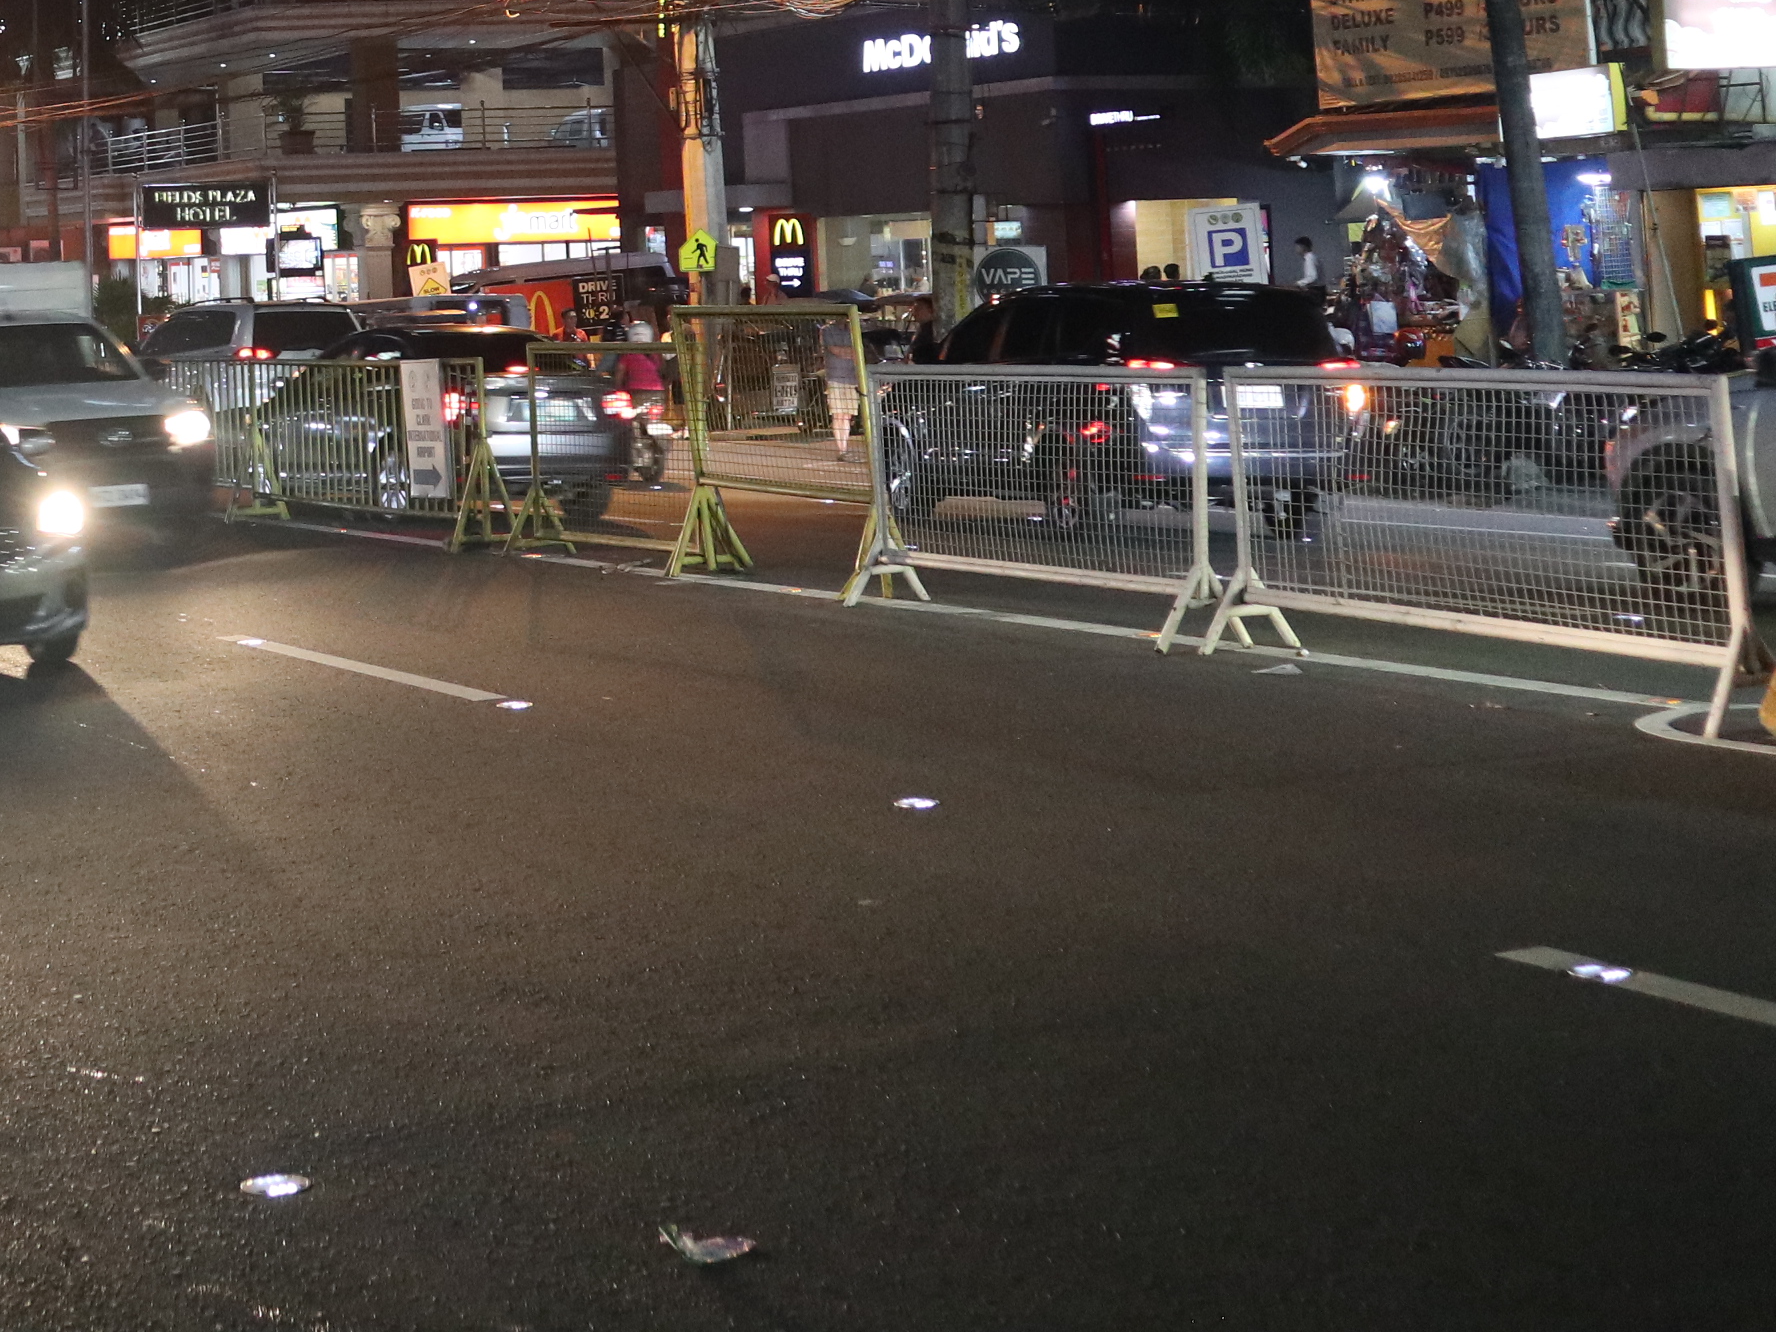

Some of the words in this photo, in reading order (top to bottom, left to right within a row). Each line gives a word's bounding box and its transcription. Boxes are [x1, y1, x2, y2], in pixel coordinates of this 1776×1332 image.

[1331, 7, 1395, 31] DELUXE
[1332, 34, 1390, 56] FAMILY
[1425, 26, 1466, 47] P599
[1523, 15, 1561, 36] URS
[154, 189, 205, 204] FIELDS
[208, 188, 257, 203] PLAZA
[176, 205, 237, 221] HOTEL
[1212, 231, 1244, 266] P
[775, 256, 806, 268] DRIVE
[777, 267, 804, 278] THRU
[980, 267, 1036, 285] VAPE
[423, 286, 441, 294] SLOW
[411, 397, 425, 410] GOING
[426, 397, 433, 410] TO
[415, 413, 432, 426] CLARK
[407, 429, 443, 442] INTERNATIONAL
[416, 446, 436, 458] AIRPORT
